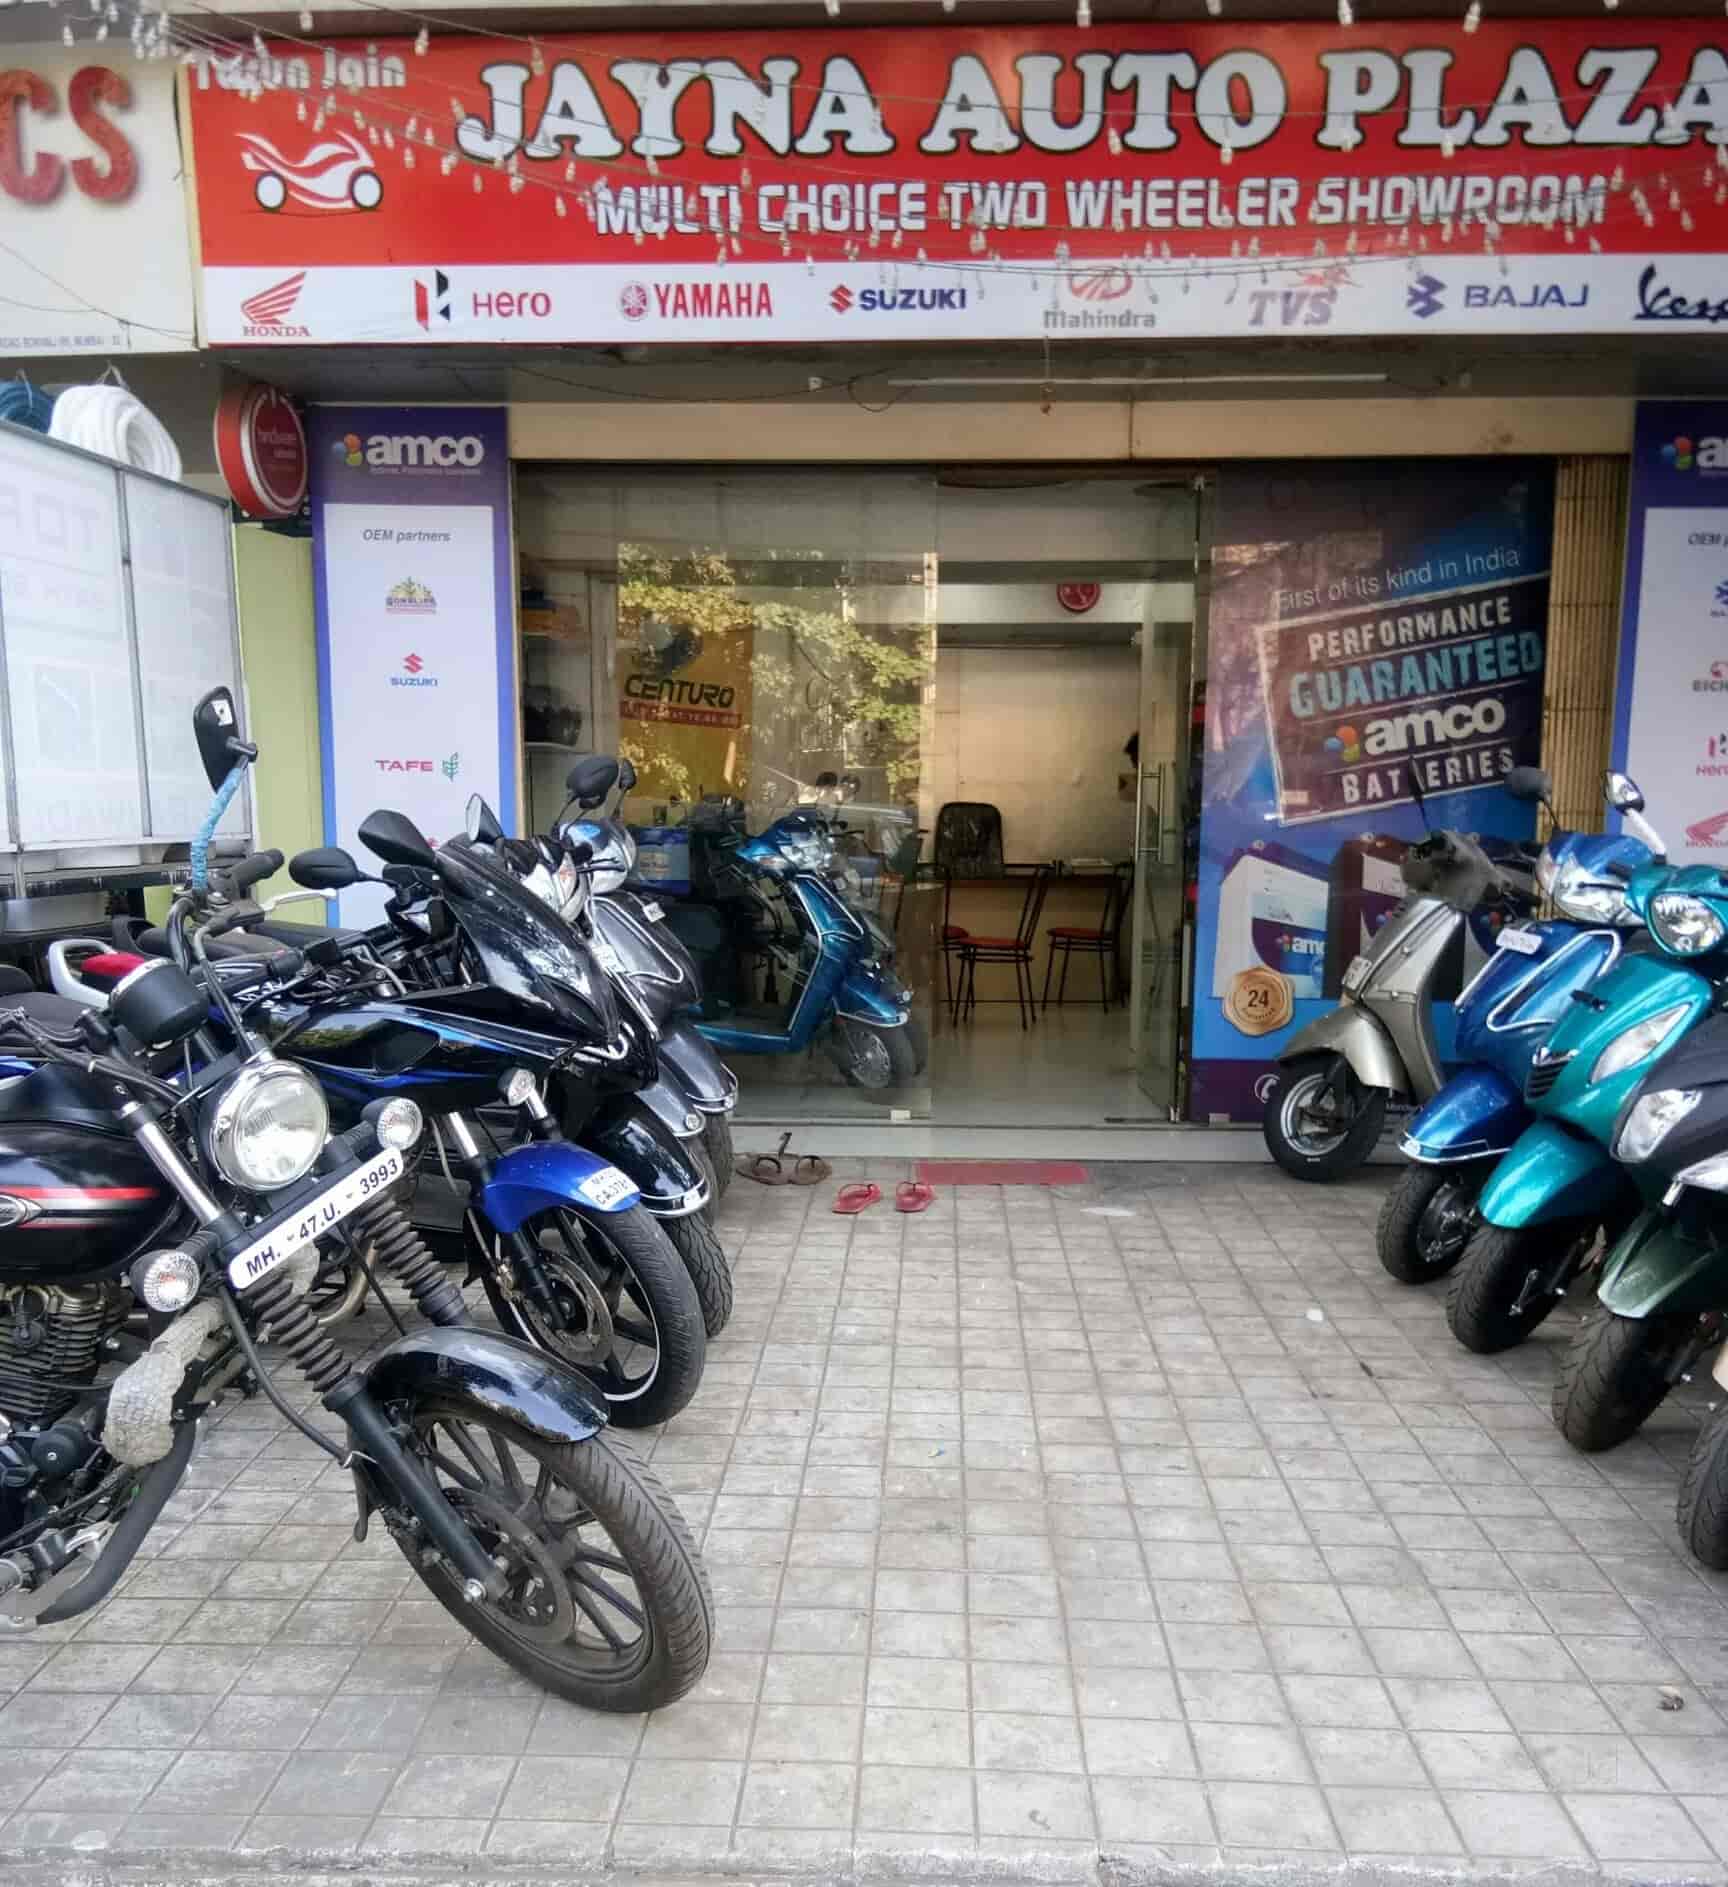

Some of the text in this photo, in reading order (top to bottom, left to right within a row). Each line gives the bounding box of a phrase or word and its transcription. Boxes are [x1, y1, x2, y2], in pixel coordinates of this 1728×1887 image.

[321, 43, 405, 89] Jain
[456, 56, 896, 160] JAYNA
[920, 48, 1287, 153] AUTO
[597, 174, 1606, 235] MULTI CHOICE TWO WHEELER SHOWROOM
[472, 291, 551, 319] Hero
[653, 282, 773, 319] YAMAHA
[859, 287, 967, 311] SUZUKI
[1249, 288, 1333, 326] TVS
[1464, 284, 1589, 310] BAJAJ
[243, 326, 311, 338] HONDA
[1043, 310, 1156, 329] Mahindra
[366, 434, 484, 467] amco
[363, 528, 452, 544] OEM partners
[1275, 547, 1520, 612] First of its kind in India
[1308, 597, 1512, 661] PERFORMANCE
[390, 677, 438, 687] SUZUKI
[624, 674, 736, 709] CENTURO
[1289, 631, 1544, 718] GUARANTEED
[1364, 698, 1505, 755] amco
[375, 759, 434, 772] TAFE
[1342, 748, 1515, 803] BATERIES
[1247, 989, 1269, 1008] 24
[245, 1245, 281, 1277] MH.
[359, 1158, 398, 1195] 3993
